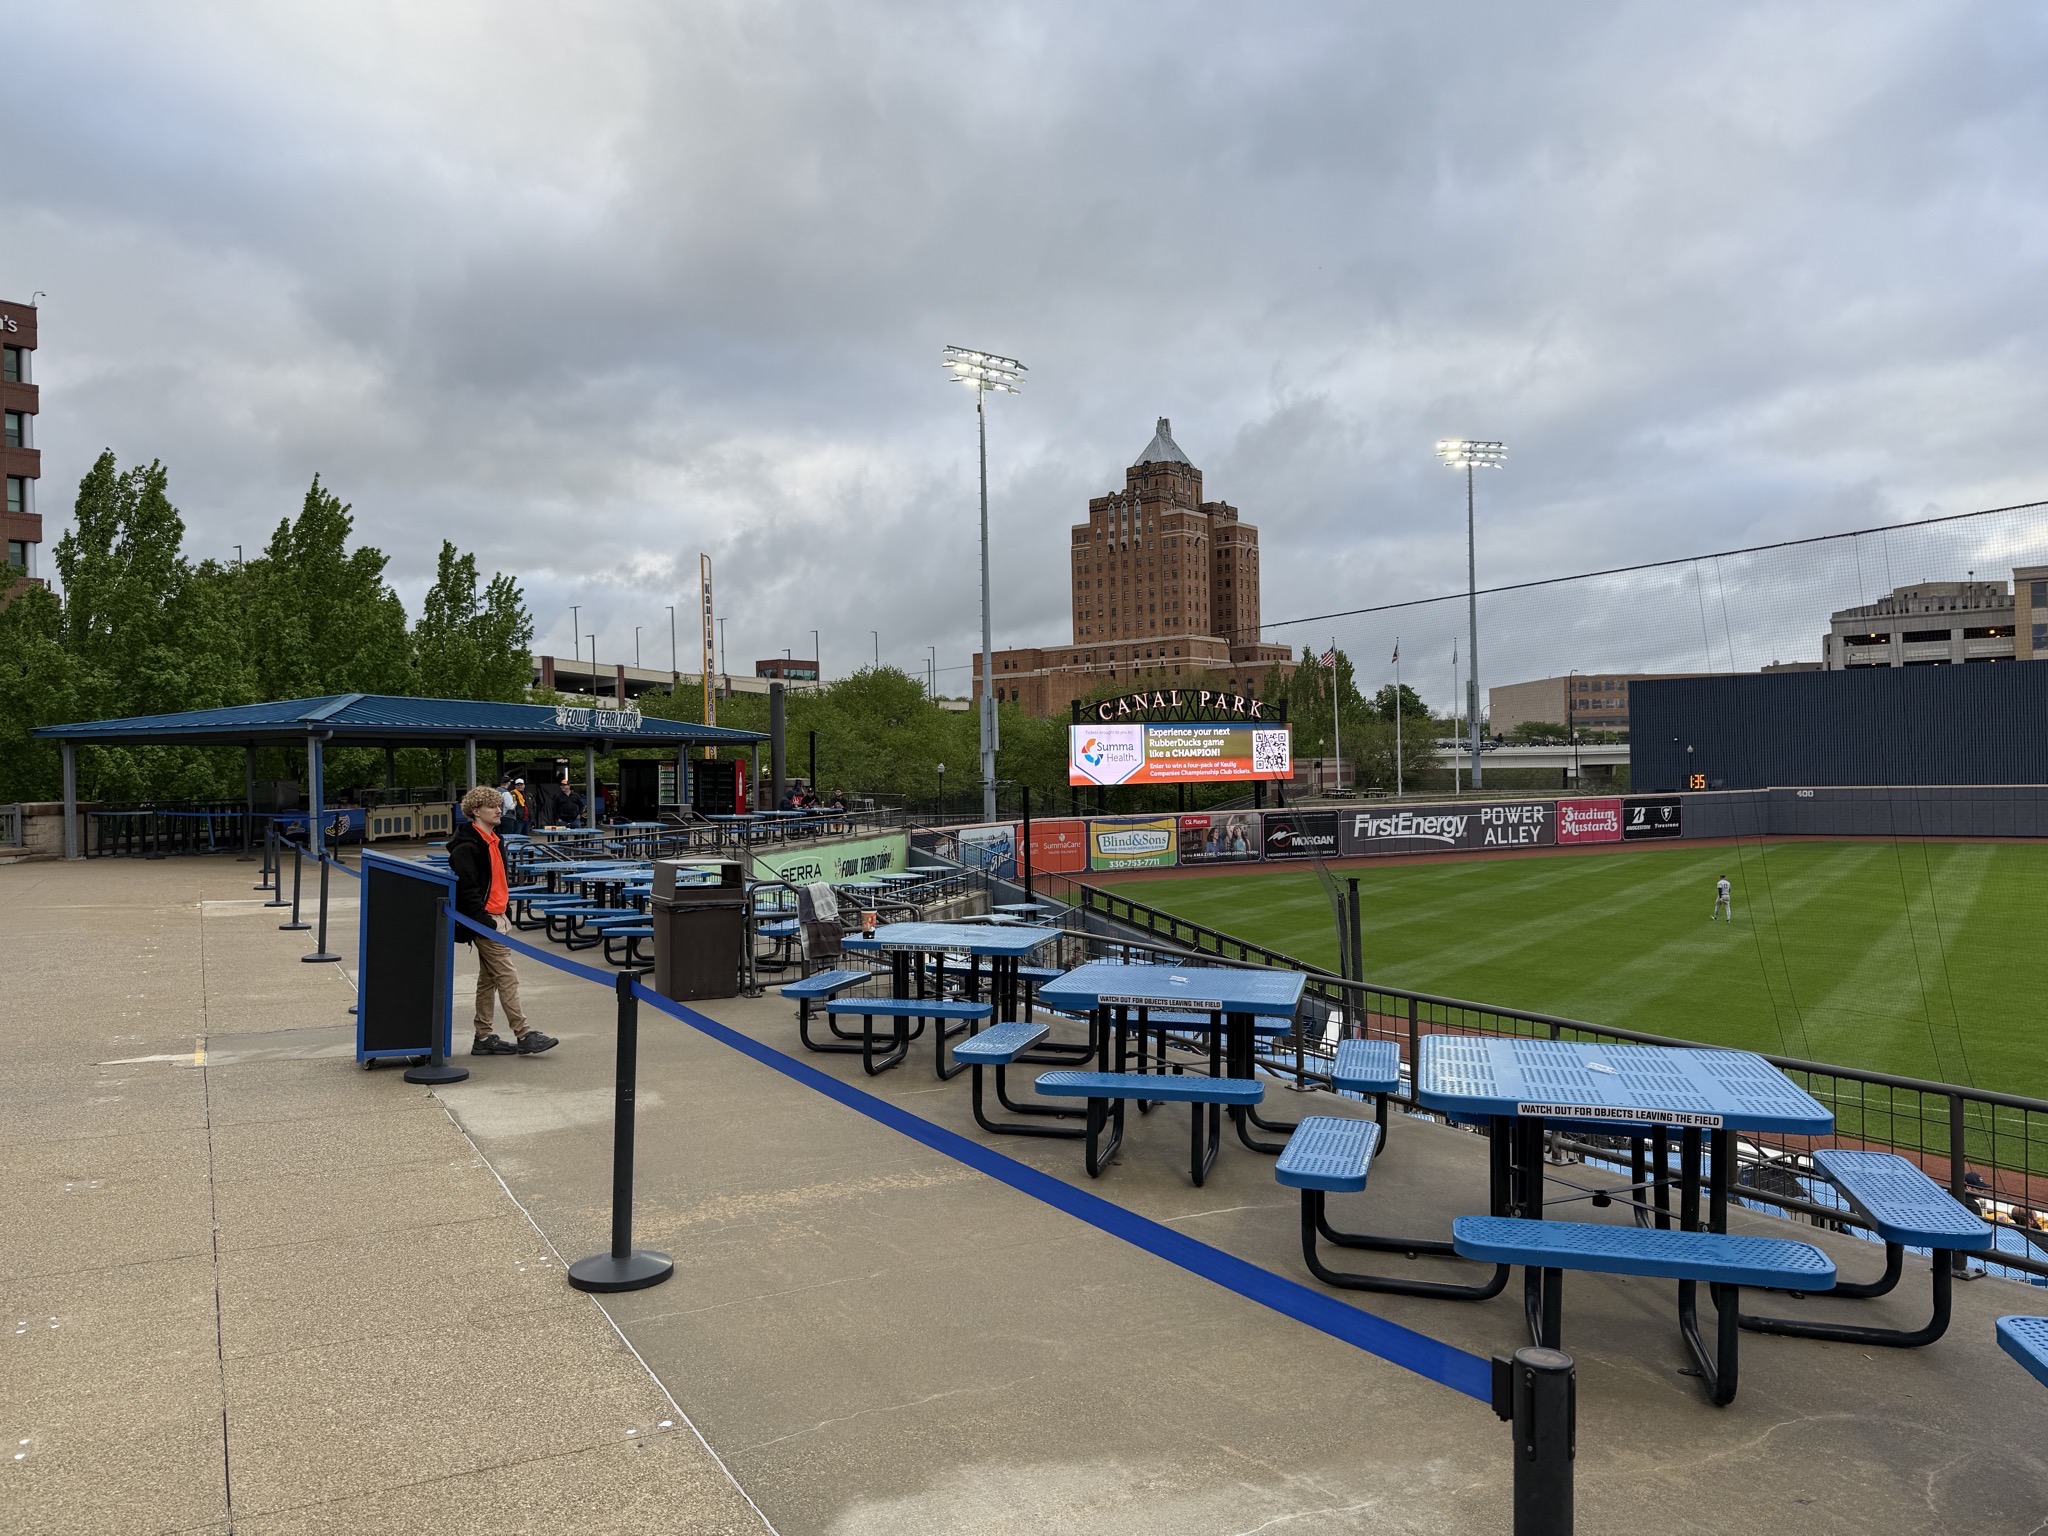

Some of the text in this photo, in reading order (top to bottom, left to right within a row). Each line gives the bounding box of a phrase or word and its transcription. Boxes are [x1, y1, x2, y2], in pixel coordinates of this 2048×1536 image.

[704, 583, 712, 650] Kaulig
[1099, 690, 1263, 720] CANAL PARK
[566, 709, 638, 728] FOWL TERRITORY
[1149, 728, 1192, 738] Experience
[1194, 729, 1212, 737] your
[1097, 742, 1134, 751] Summa
[1149, 738, 1224, 748] RubberDucks game
[1149, 749, 1164, 758] like
[1172, 749, 1220, 757] CHAMPION!
[1481, 806, 1544, 825] POWER
[1562, 807, 1617, 821] Stadium
[1354, 812, 1467, 837] FirstEnergy
[1561, 820, 1618, 835] Mustard
[1292, 836, 1334, 846] MORGAN
[1484, 826, 1541, 844] ALLEY
[841, 852, 891, 878] FOWL TERRITORY
[1109, 858, 1160, 868] 330-753-7711
[781, 863, 822, 882] SERRA
[1521, 1104, 1719, 1126] WATCH OUT FOR OBJECTS LEAVING THE FIELD
